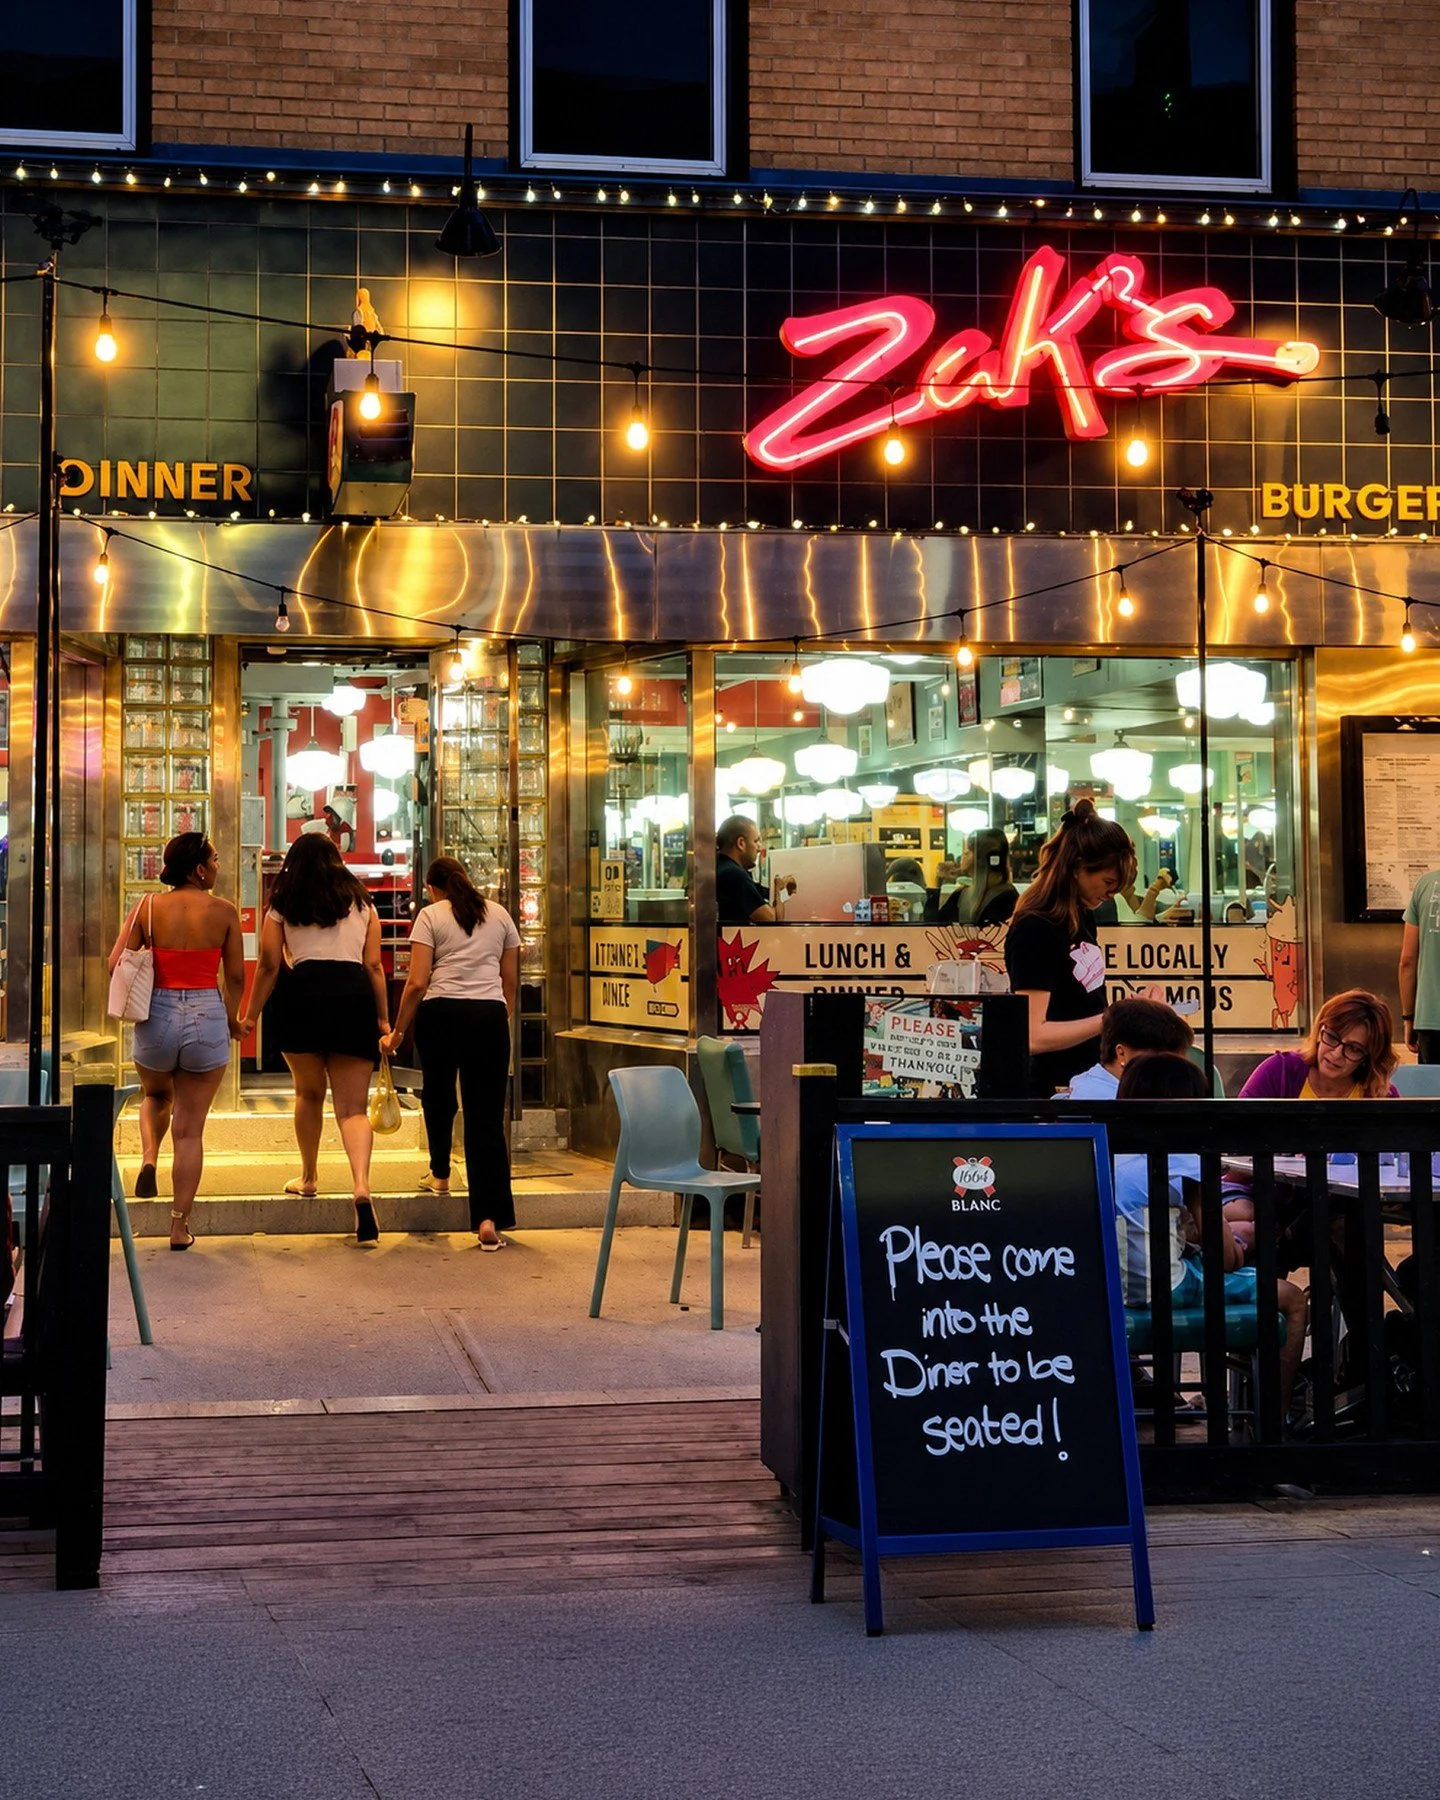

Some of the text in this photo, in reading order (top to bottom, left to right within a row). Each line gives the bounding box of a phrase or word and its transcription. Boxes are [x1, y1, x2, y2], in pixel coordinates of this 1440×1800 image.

[60, 458, 253, 502] DINNER
[805, 943, 912, 969] LUNCH &
[1126, 943, 1229, 969] LOCALY
[891, 1016, 956, 1038] PLEASE
[959, 1170, 989, 1183] 1664
[951, 1199, 1002, 1212] BLANC
[879, 1225, 1076, 1300] Please come
[922, 1301, 1033, 1339] into the
[880, 1349, 1076, 1399] Diner to be
[922, 1397, 1069, 1461] seated!
